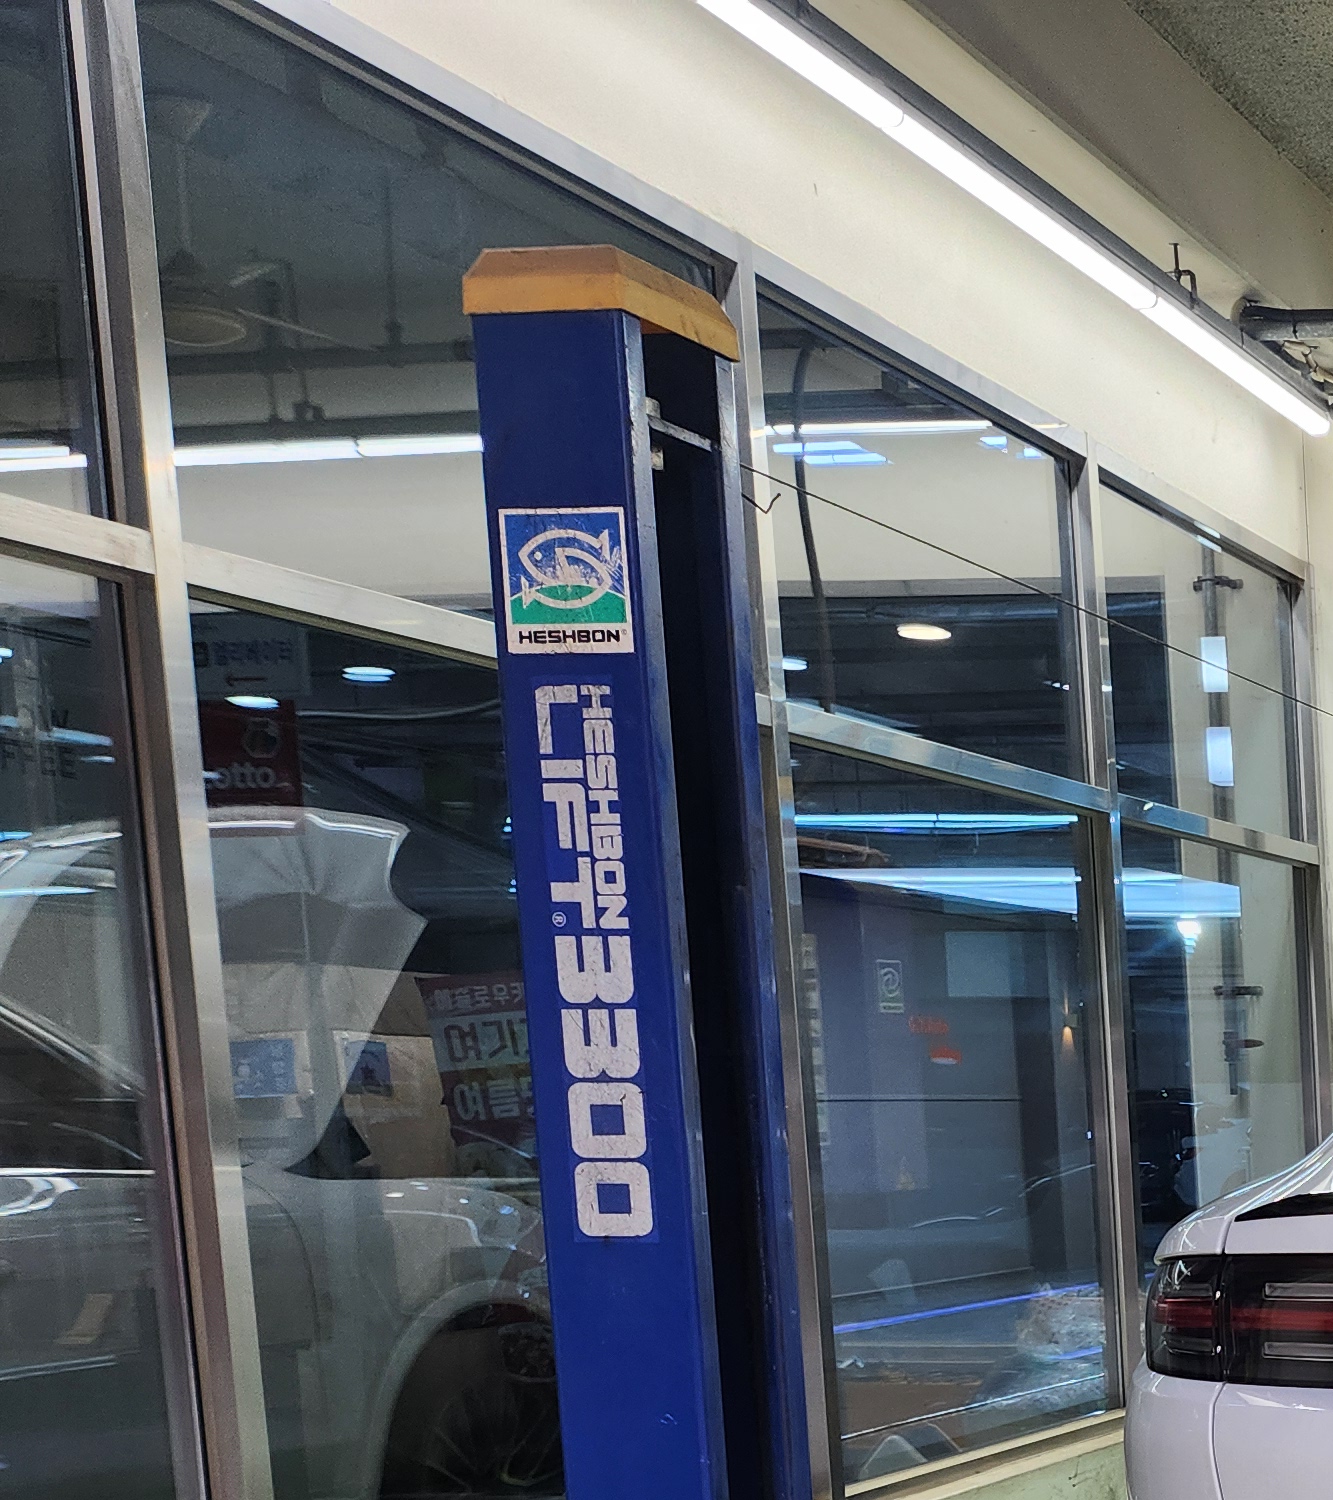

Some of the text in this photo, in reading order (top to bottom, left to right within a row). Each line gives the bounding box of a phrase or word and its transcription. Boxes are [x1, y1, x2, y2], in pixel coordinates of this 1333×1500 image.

[518, 628, 621, 644] HESHBON
[204, 761, 277, 789] otto
[534, 684, 597, 929] LIFT
[580, 684, 631, 930] HESHBON
[554, 935, 654, 1238] 3300
